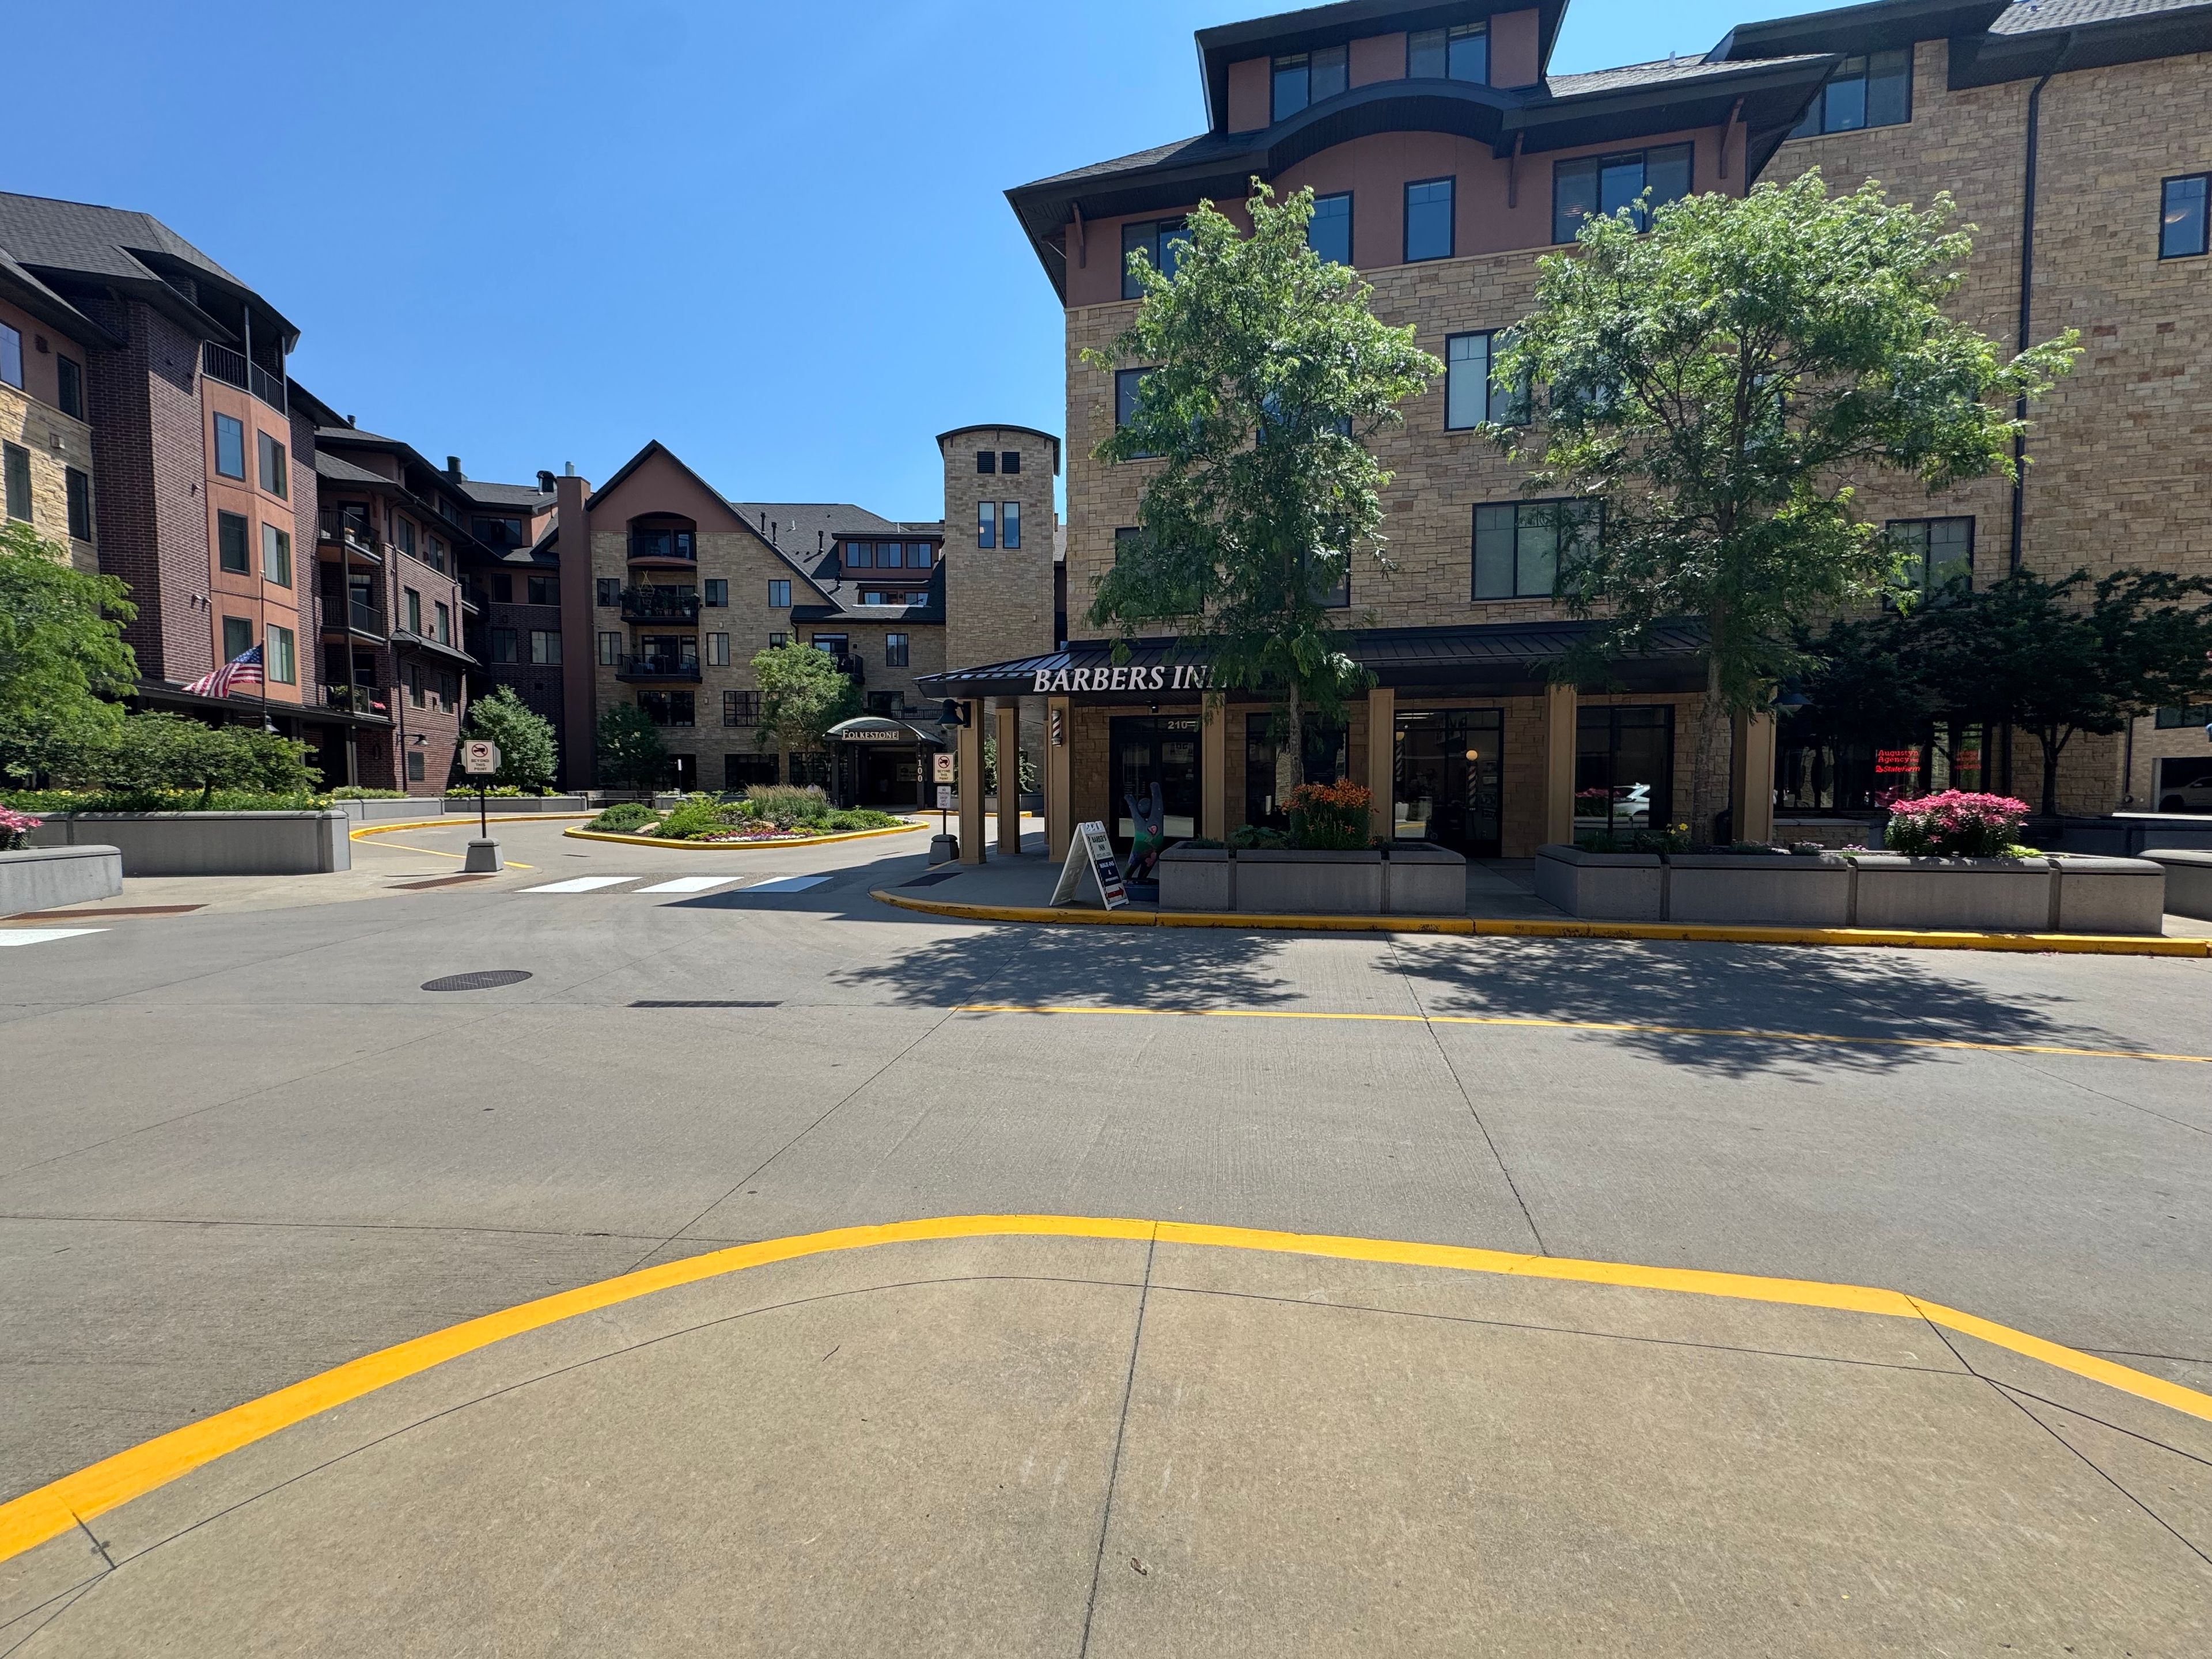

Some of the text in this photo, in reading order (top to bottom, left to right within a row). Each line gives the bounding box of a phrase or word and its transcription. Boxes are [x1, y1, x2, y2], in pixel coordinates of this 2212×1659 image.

[1033, 666, 1165, 691] BARBERS
[1168, 721, 1188, 729] 210
[842, 729, 898, 740] FOLKESTONE
